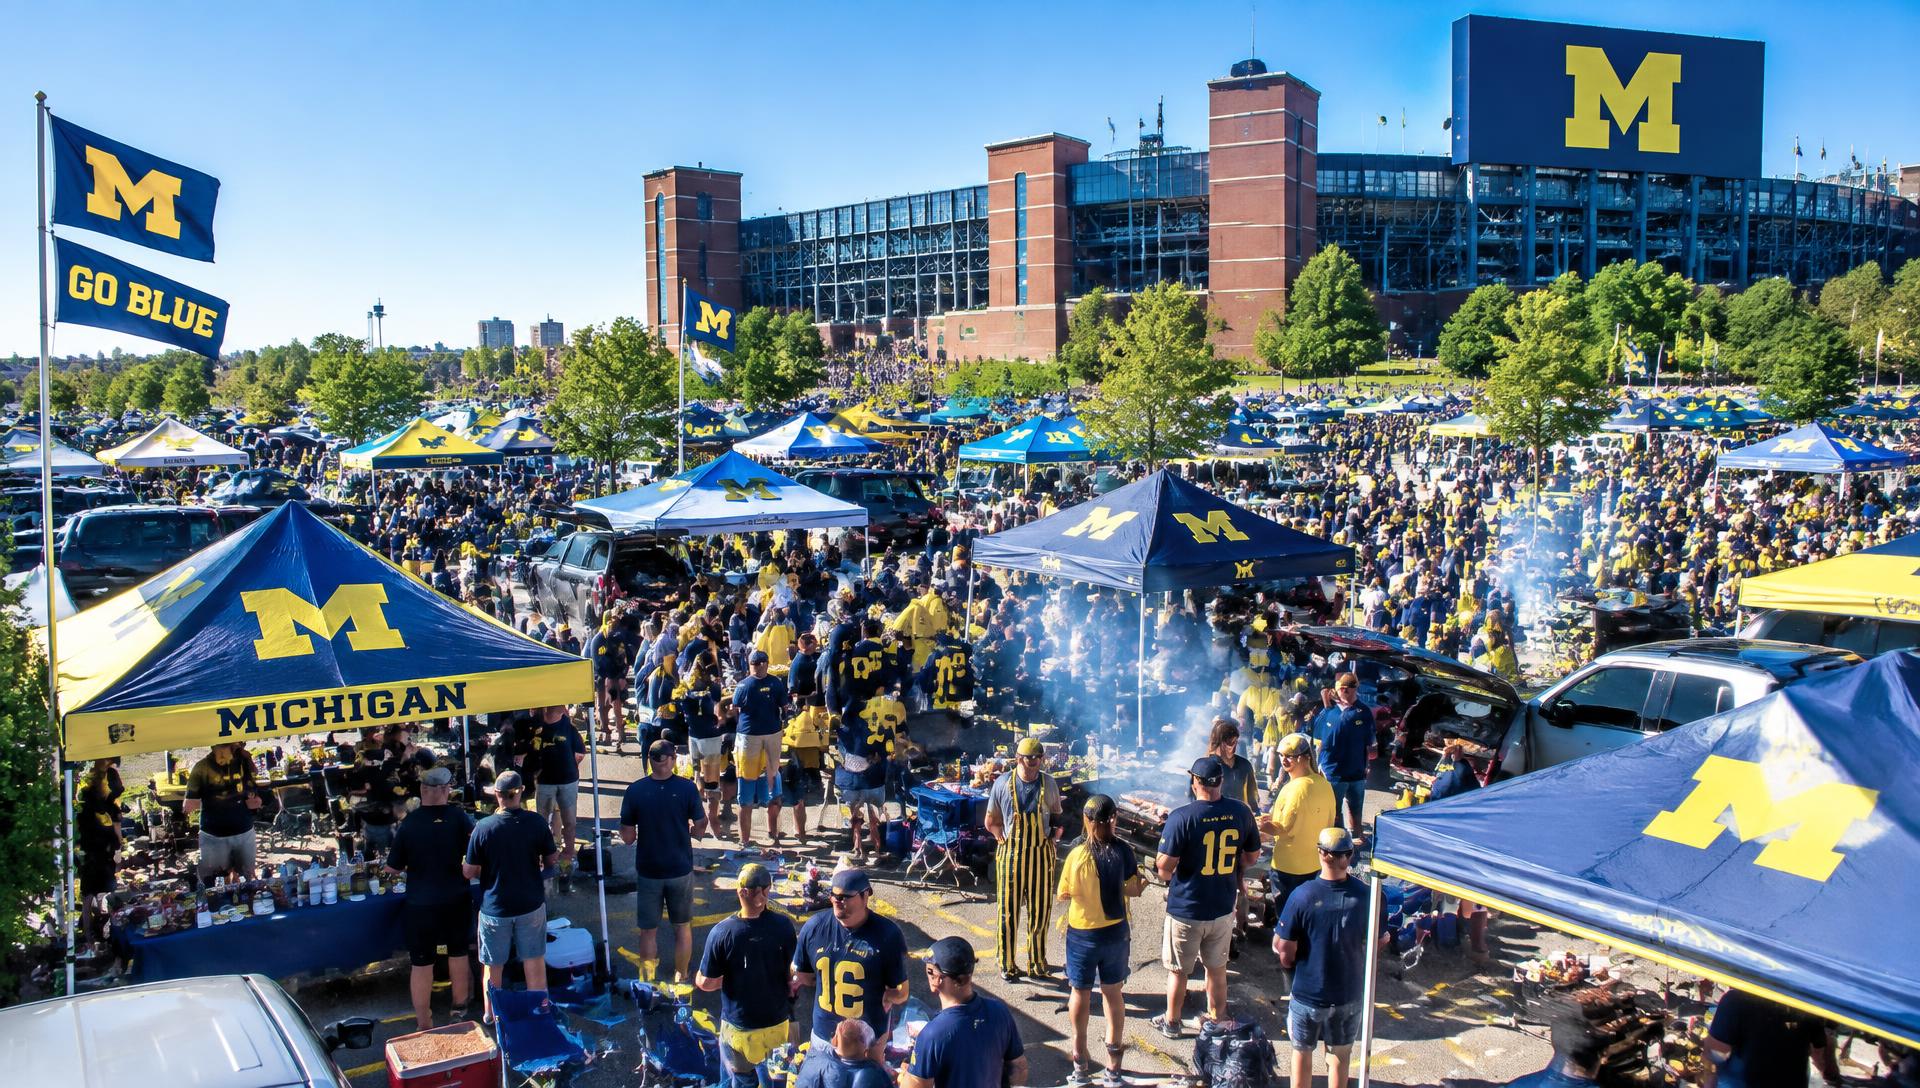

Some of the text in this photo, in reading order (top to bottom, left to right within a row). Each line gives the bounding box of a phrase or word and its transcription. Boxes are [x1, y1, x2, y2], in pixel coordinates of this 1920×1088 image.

[1565, 45, 1682, 154] M
[85, 144, 182, 239] M
[68, 264, 218, 339] GO BLUE
[695, 300, 732, 340] M
[717, 477, 782, 503] M
[1062, 506, 1139, 541] M
[1172, 510, 1250, 544] M
[240, 583, 405, 661] M
[217, 682, 468, 736] MICHIGAN
[1642, 754, 1879, 882] M
[1200, 828, 1240, 876] 16
